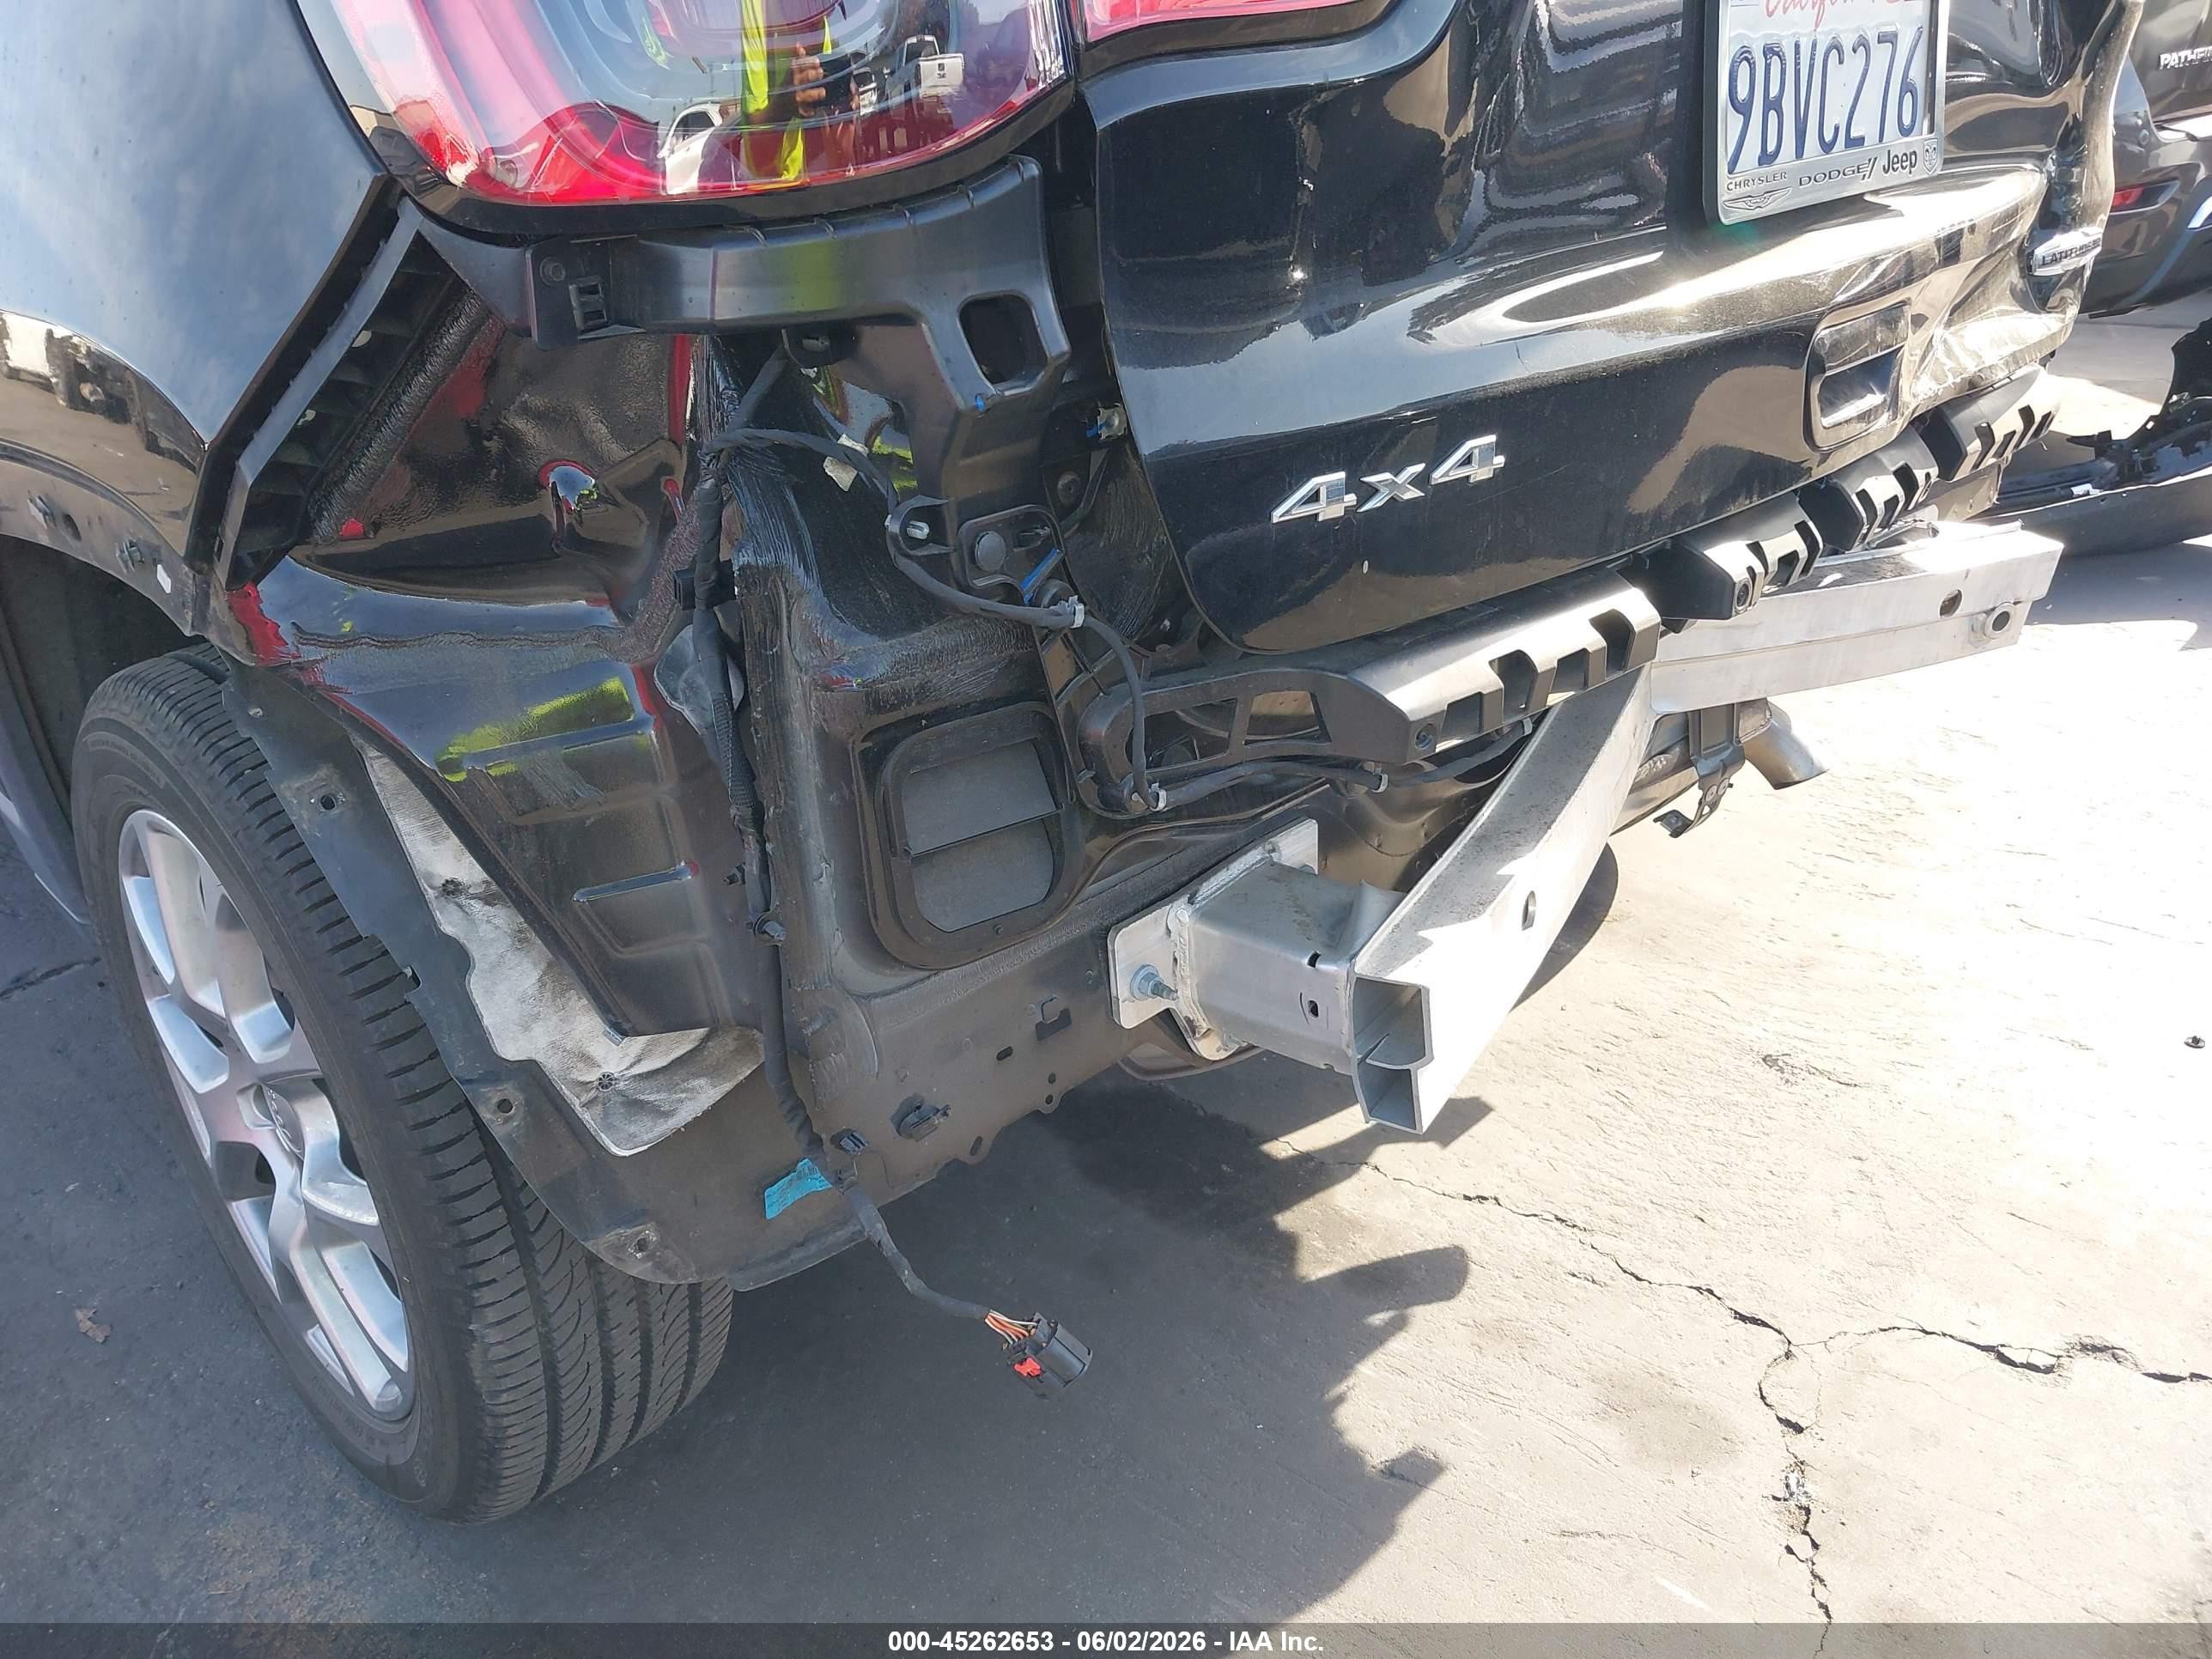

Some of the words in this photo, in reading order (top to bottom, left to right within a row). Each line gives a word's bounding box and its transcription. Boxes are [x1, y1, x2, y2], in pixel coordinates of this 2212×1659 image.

[2159, 46, 2212, 70] PATHFI
[1727, 23, 1923, 174] 9BVC276
[1726, 171, 1788, 192] CHRYSLER
[1799, 164, 1869, 187] DODGE
[1882, 149, 1917, 175] Jeep
